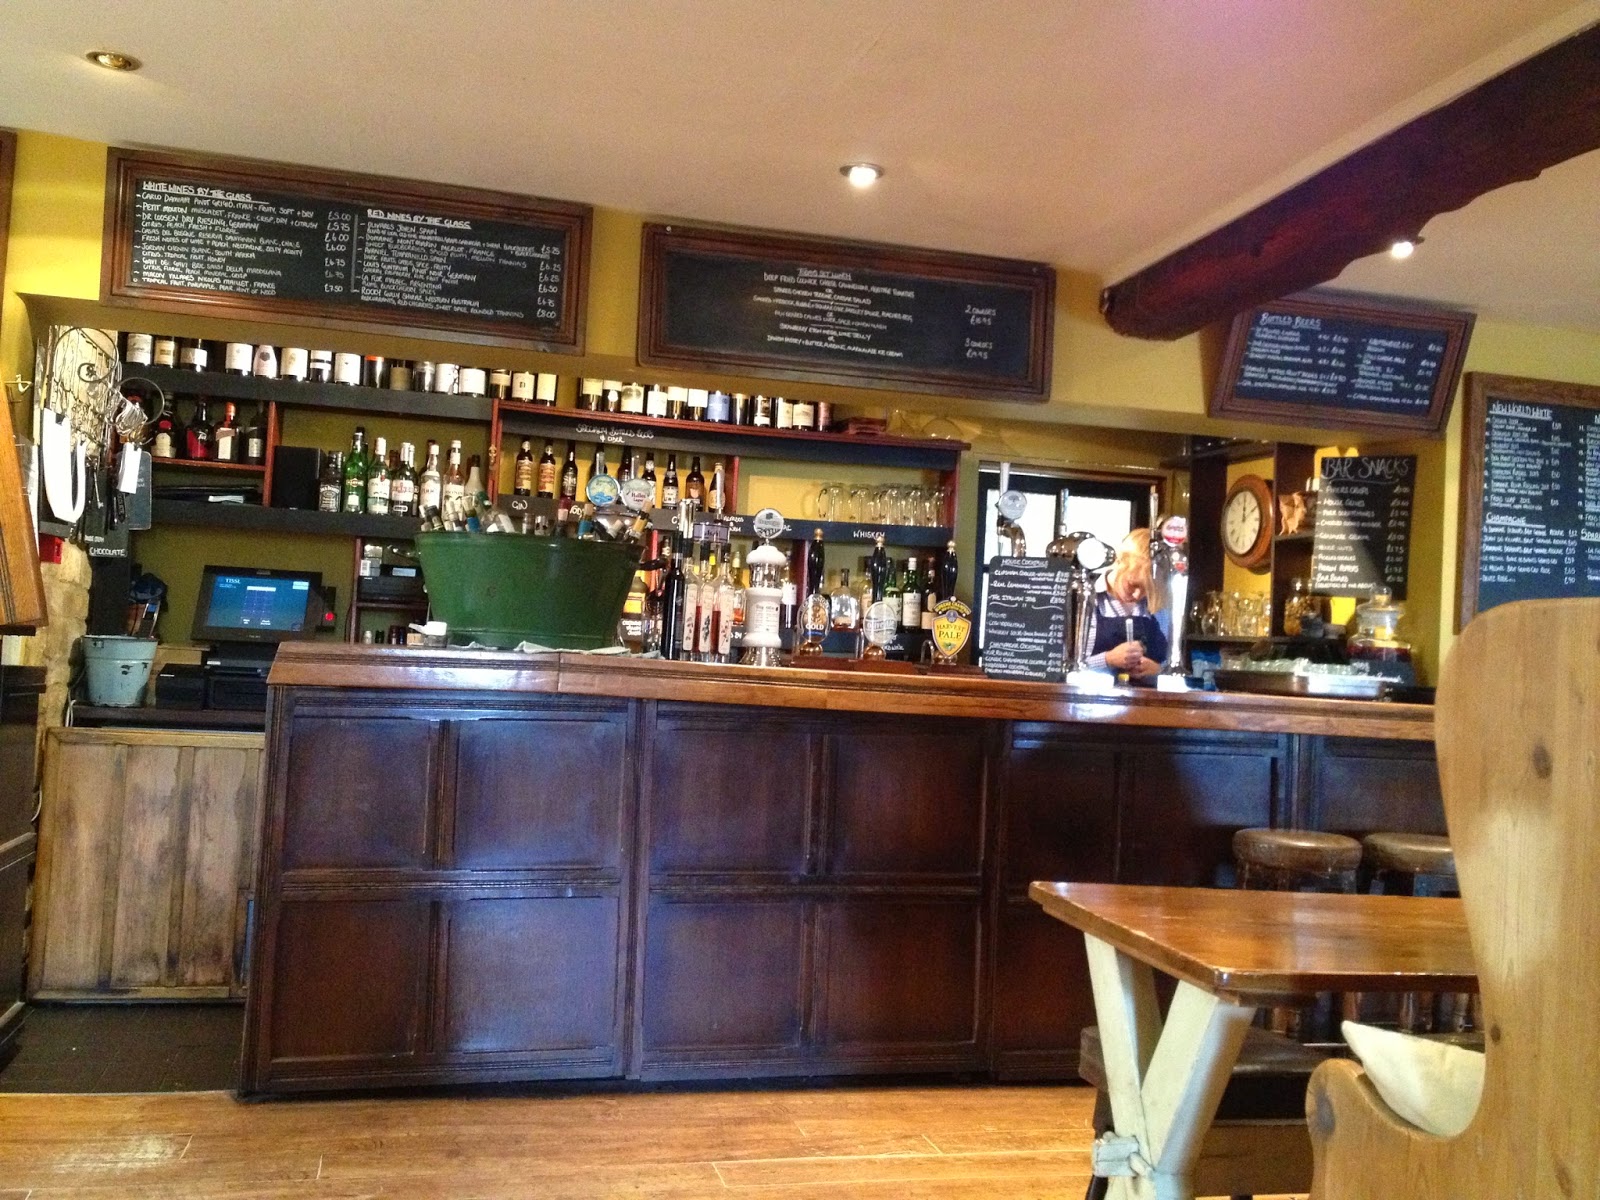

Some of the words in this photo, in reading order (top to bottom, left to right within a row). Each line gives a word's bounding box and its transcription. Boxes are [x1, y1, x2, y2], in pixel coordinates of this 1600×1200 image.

[142, 182, 168, 193] WHITE
[169, 185, 194, 195] WINES
[197, 188, 209, 196] BY
[226, 191, 252, 201] GLASS
[143, 202, 161, 212] PETIT
[279, 208, 294, 216] SOFT
[302, 210, 314, 218] DRY
[142, 212, 152, 221] DR
[182, 216, 194, 225] DRY
[367, 209, 384, 219] RED
[387, 211, 412, 222] WINES
[413, 214, 425, 224] BY
[426, 216, 442, 226] THE
[444, 218, 471, 229] GLASS
[1358, 457, 1409, 479] SNACKS
[512, 500, 528, 510] GIN
[90, 546, 125, 556] CHOCOLATE
[936, 624, 965, 632] HARVEST
[939, 631, 961, 639] PALE
